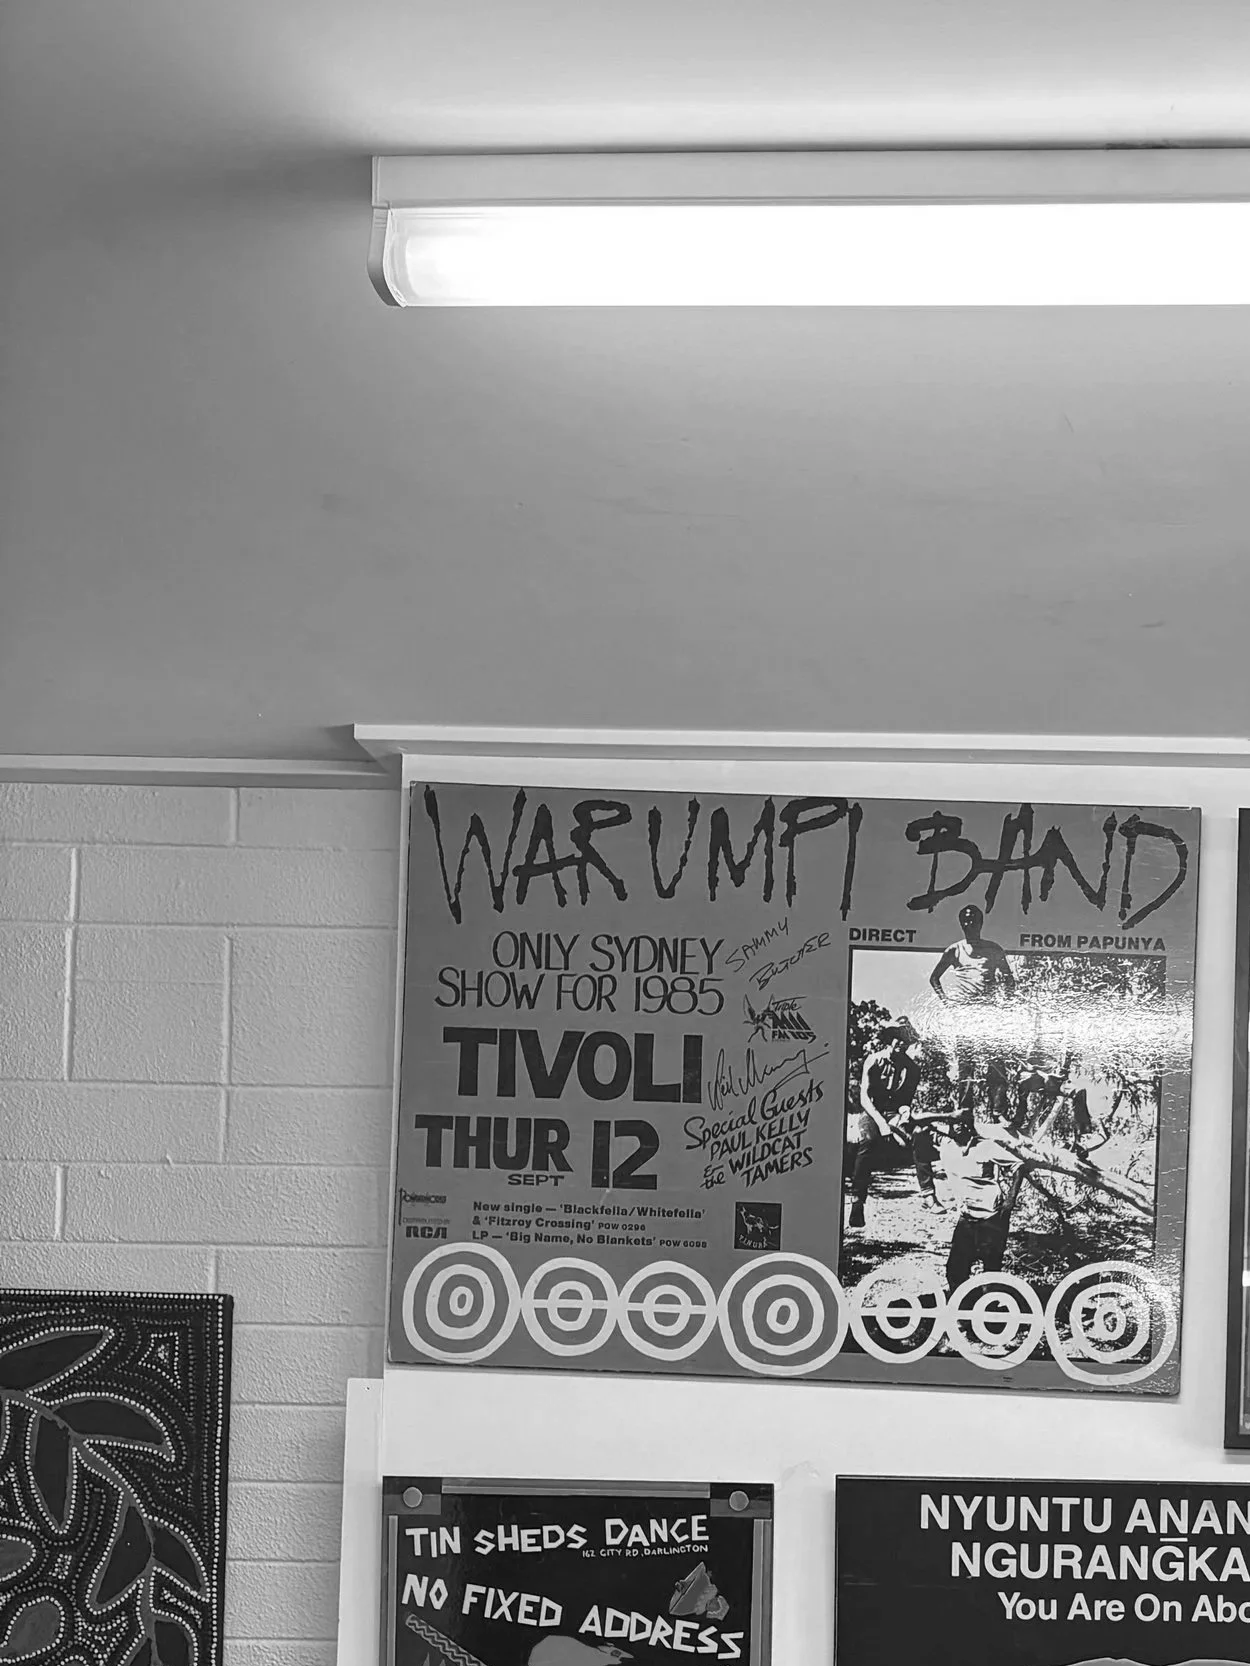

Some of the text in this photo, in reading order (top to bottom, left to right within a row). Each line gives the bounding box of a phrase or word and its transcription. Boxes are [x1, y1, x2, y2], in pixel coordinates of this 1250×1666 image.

[425, 784, 1189, 930] WARUMPI BAND
[492, 930, 725, 974] ONLY SYDNEY
[848, 928, 1167, 952] DIRECT FROM PAPUNYA
[434, 967, 725, 1015] SHOW FOR 1985
[442, 1026, 704, 1104] TIVOLI
[683, 1079, 824, 1150] Special Guests
[710, 1108, 811, 1161] PAUL KELLY
[414, 1113, 661, 1191] THUR 12
[729, 1128, 807, 1175] WILDCAT
[741, 1147, 814, 1188] TAMERS
[507, 1174, 565, 1187] SEPT
[473, 1201, 501, 1212] New
[503, 1202, 543, 1214] single
[472, 1230, 489, 1241] LP
[577, 1233, 594, 1245] No
[920, 1493, 1112, 1534] NYUNTU
[405, 1514, 710, 1557] TIN SHEDS DANCE
[600, 1548, 622, 1557] CITY
[951, 1541, 1250, 1582] NGURANGKA
[402, 1573, 744, 1660] NO FIXED ADDRESS
[997, 1591, 1057, 1621] You
[1066, 1593, 1125, 1621] Are
[1134, 1593, 1182, 1622] On
